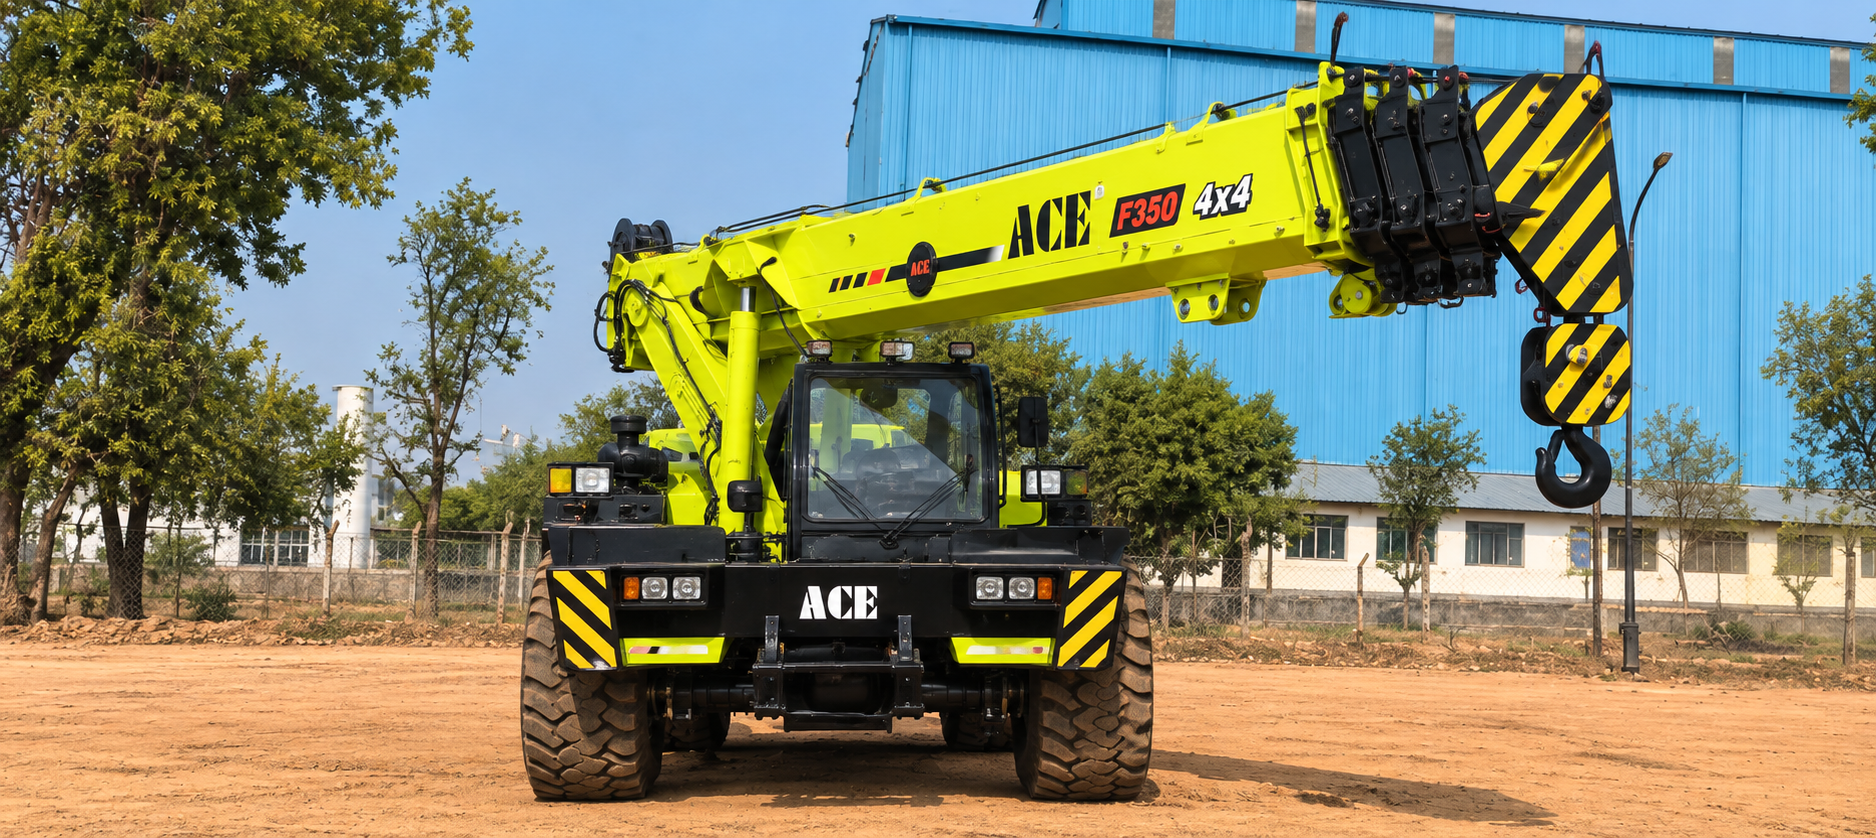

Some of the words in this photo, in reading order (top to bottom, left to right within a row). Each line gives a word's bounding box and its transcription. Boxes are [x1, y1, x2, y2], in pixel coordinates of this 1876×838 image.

[1008, 190, 1091, 260] ACE
[1116, 190, 1178, 231] F350
[1193, 173, 1253, 218] 4x4
[910, 259, 930, 277] ACE
[799, 585, 878, 620] ACE
